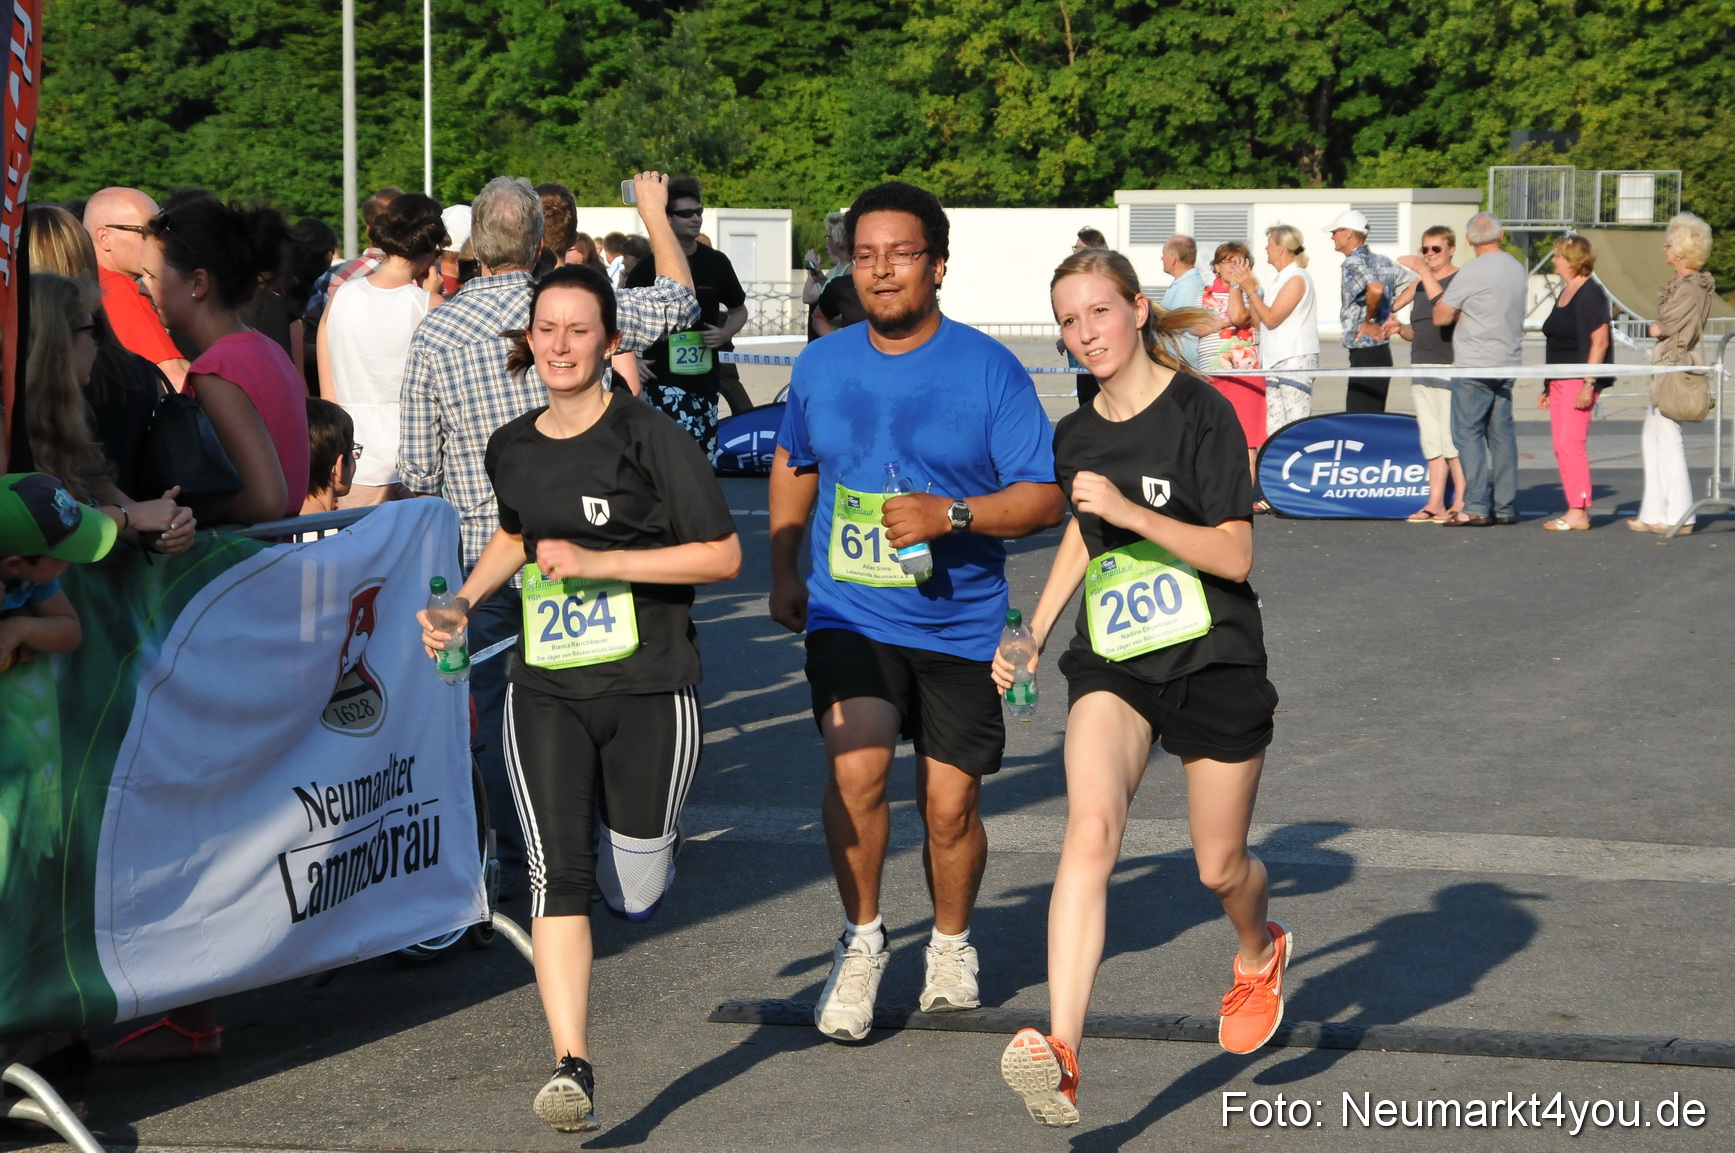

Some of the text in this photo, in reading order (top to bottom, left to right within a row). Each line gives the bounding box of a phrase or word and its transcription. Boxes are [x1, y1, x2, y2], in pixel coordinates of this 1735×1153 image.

[676, 346, 707, 365] 237
[537, 591, 617, 643] 264
[1100, 573, 1183, 635] 260
[551, 642, 571, 651] Bianca
[1120, 629, 1142, 640] Nadine
[333, 698, 375, 726] 1628
[278, 802, 441, 924] Lammsbräu
